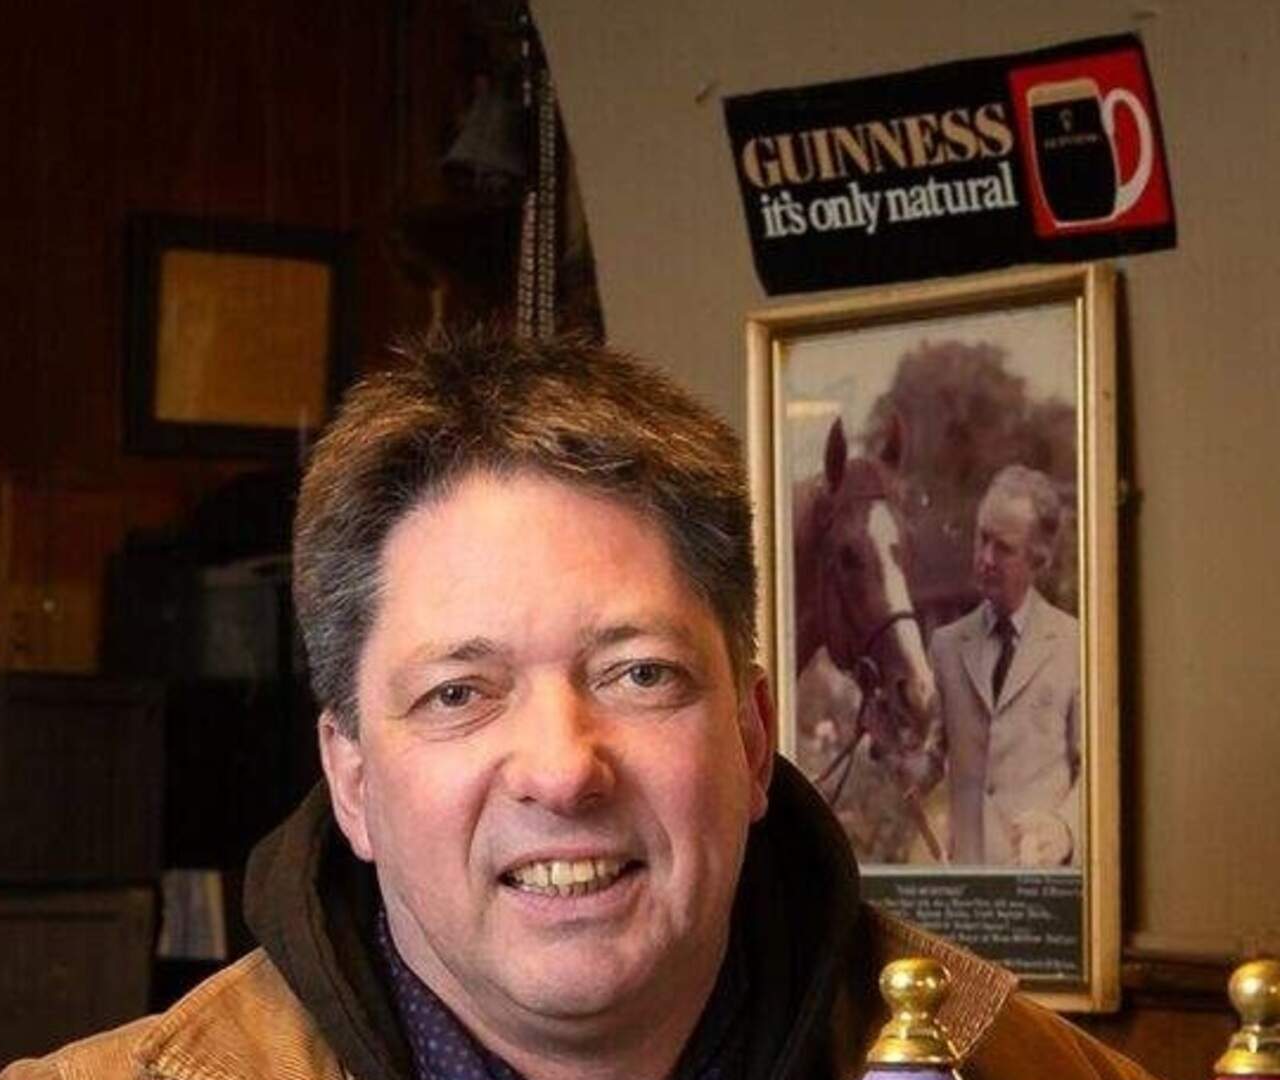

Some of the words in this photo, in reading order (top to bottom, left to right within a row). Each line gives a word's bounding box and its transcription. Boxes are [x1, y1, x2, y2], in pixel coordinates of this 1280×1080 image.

[743, 103, 1013, 189] GUINNESS
[760, 190, 808, 239] it's
[808, 181, 881, 235] only
[885, 160, 1019, 223] natural
